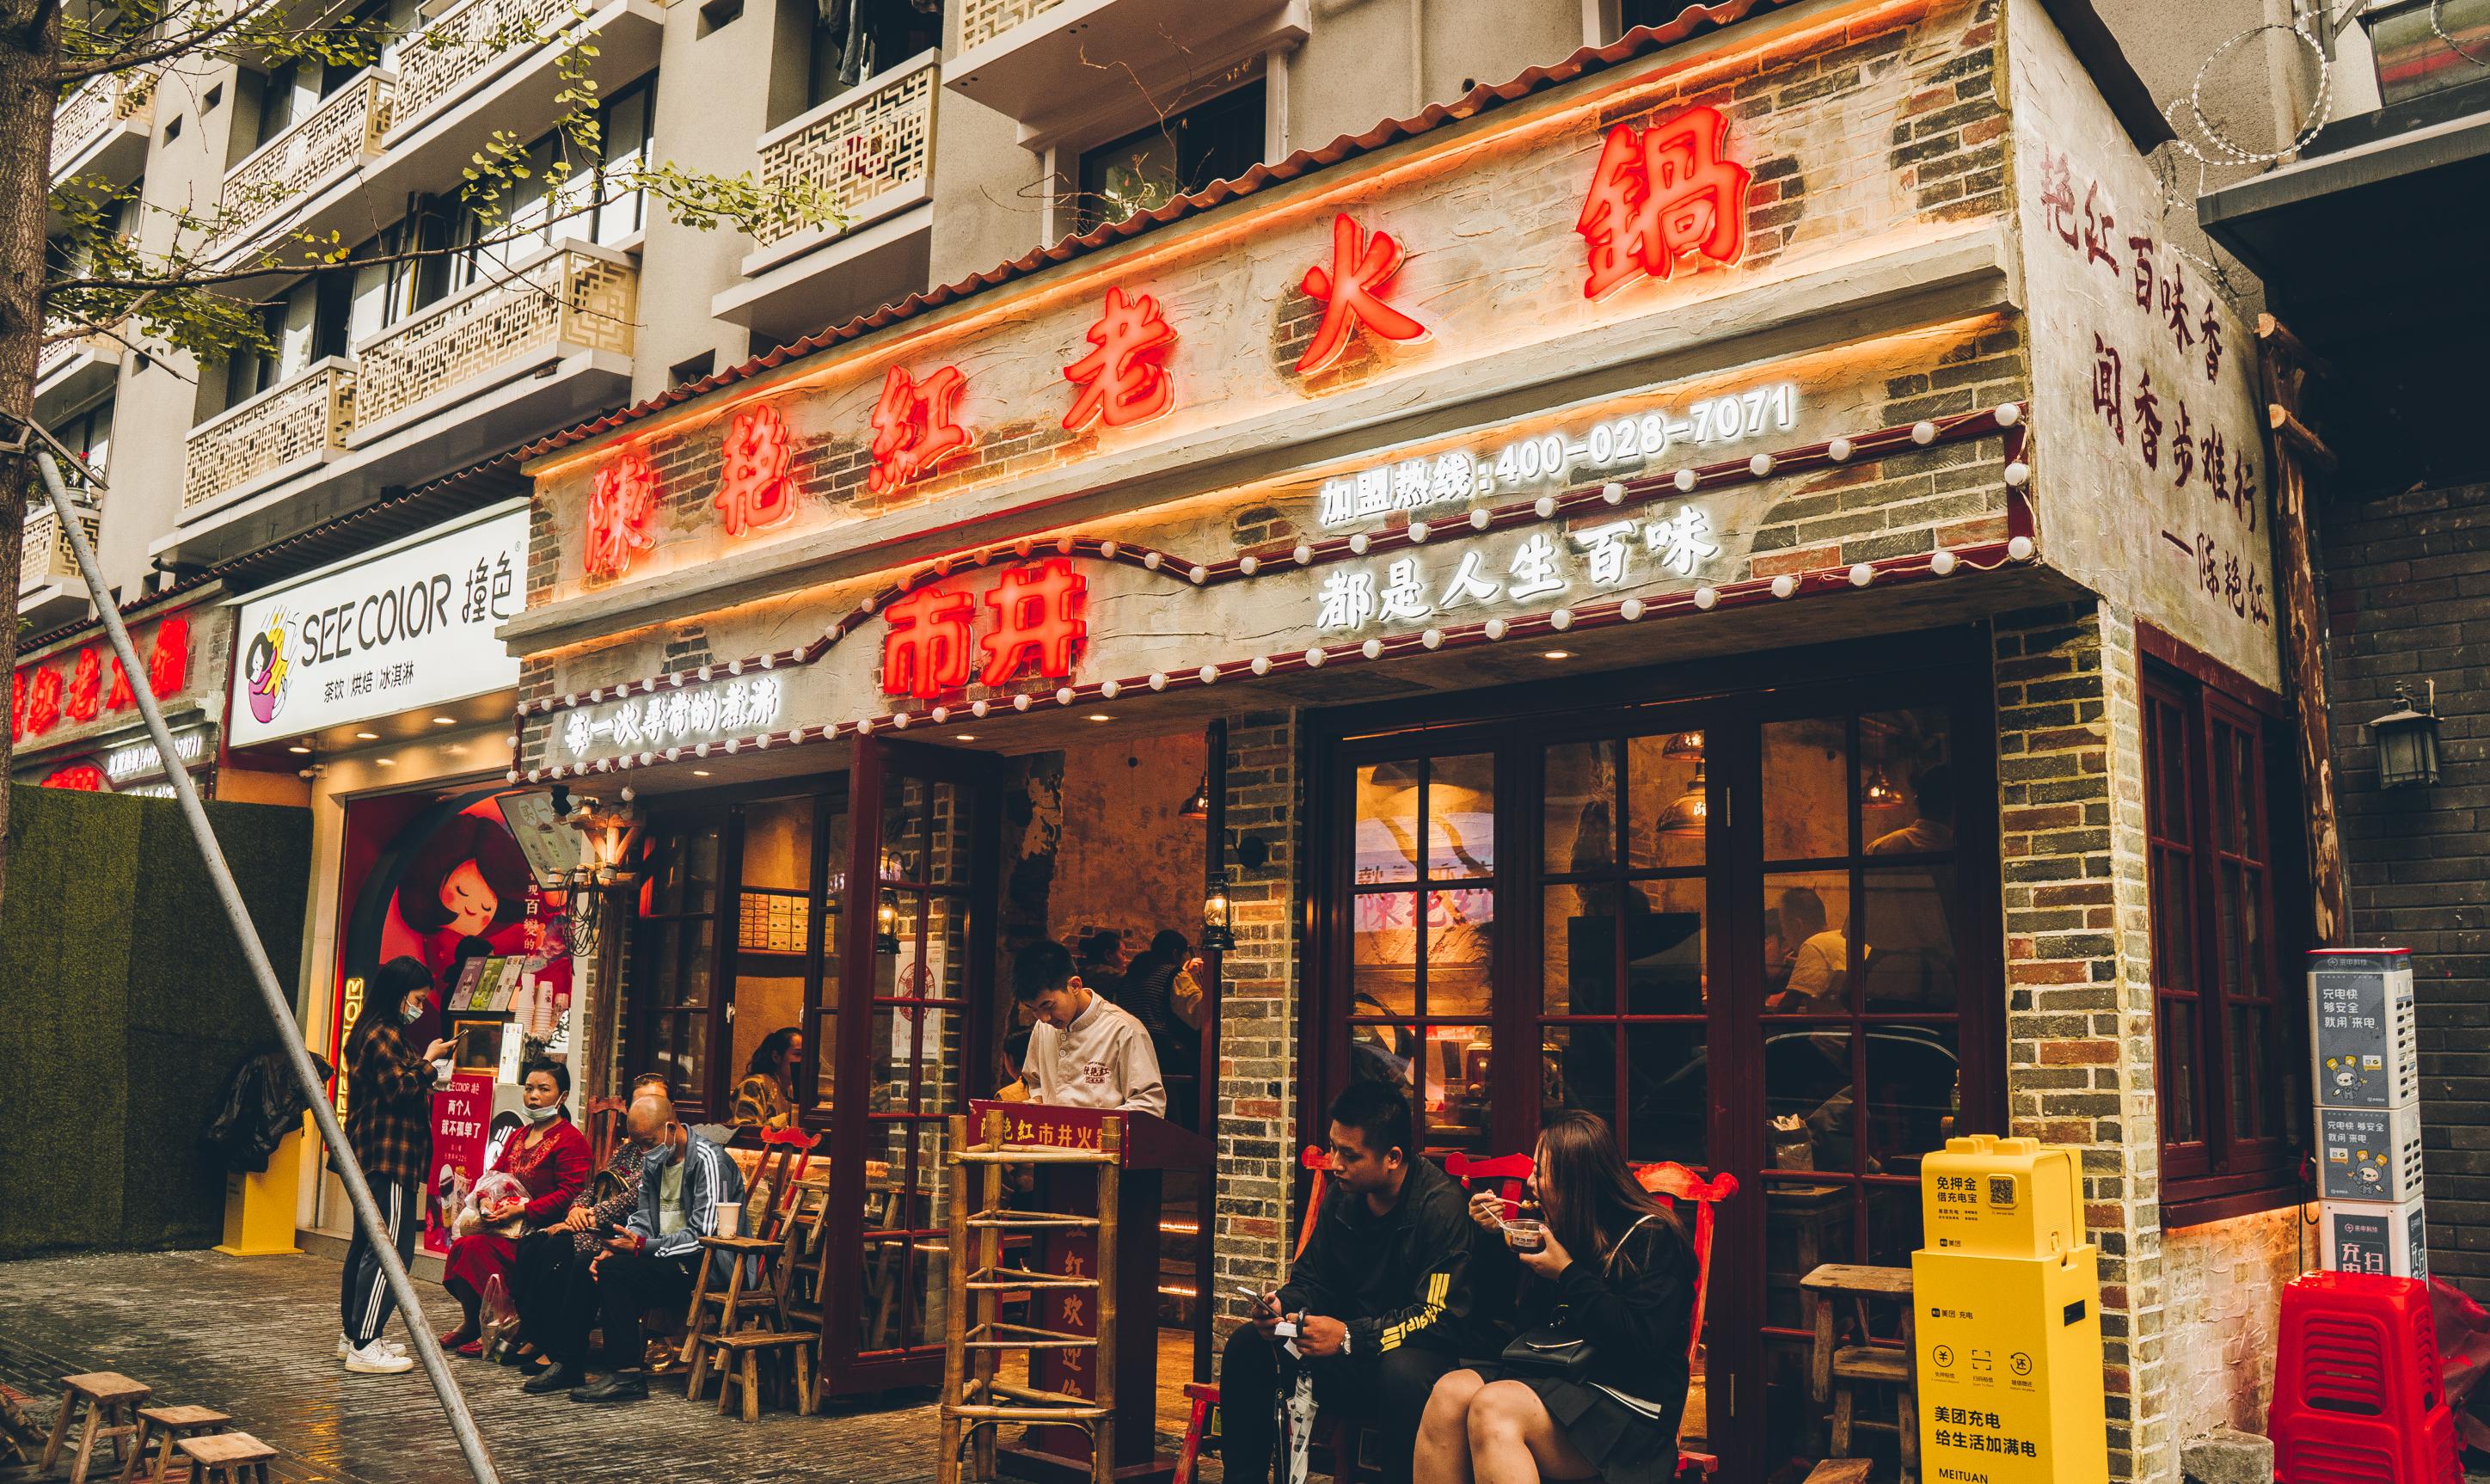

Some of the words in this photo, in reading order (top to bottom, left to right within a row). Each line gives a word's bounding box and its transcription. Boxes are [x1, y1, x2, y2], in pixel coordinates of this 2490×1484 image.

[2092, 330, 2257, 533] 闻香步难行
[1316, 506, 1720, 631] 都是人生百味
[301, 600, 356, 667] SEE
[358, 573, 452, 651] COLOR
[882, 557, 1089, 701] 市井
[323, 677, 344, 703] 茶饮
[350, 670, 373, 698] 烘焙
[379, 659, 414, 690] 冰淇淋
[2322, 988, 2358, 1000] 充电快
[2323, 1002, 2359, 1014] 够安全
[447, 1099, 471, 1117] 两个人
[440, 1119, 481, 1139] 就不孤单了
[1936, 1175, 1978, 1192] 免押金
[1937, 1192, 1978, 1204] 借充电宝
[1934, 1406, 2001, 1429] 美团充电
[1935, 1429, 2037, 1458] 给生活加满电
[1939, 1468, 1989, 1484] MEITUAN
